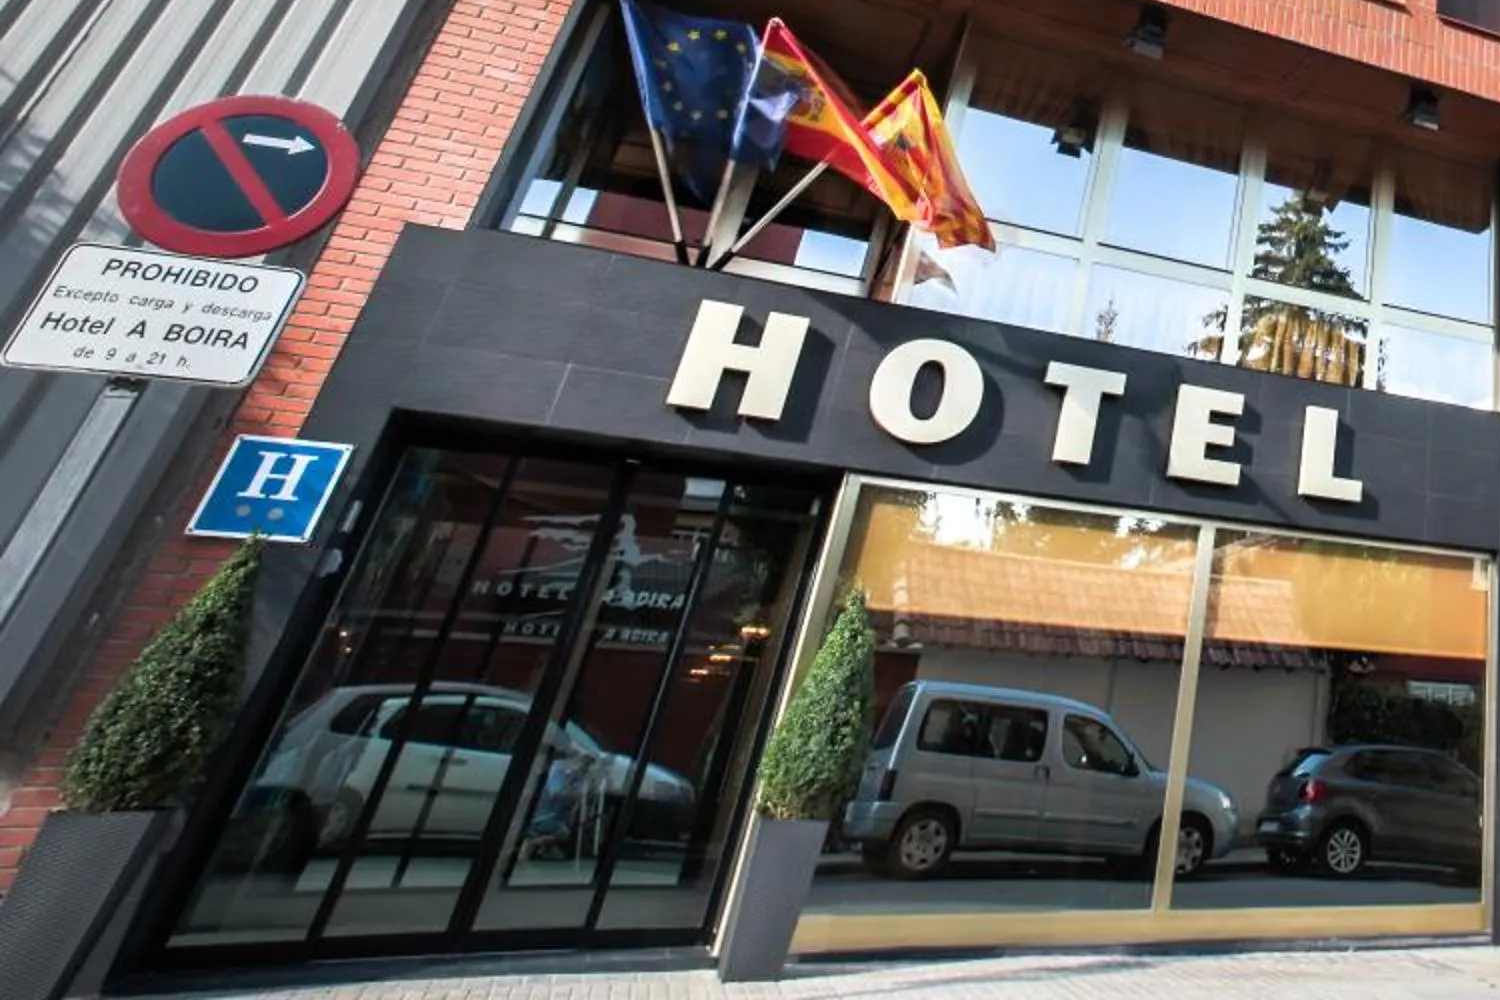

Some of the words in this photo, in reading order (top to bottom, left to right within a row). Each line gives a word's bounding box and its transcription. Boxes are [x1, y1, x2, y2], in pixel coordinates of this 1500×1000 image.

[100, 258, 259, 293] PROHIBIDO
[53, 285, 119, 305] Excepto
[129, 294, 174, 312] carga
[182, 301, 192, 314] y
[201, 300, 273, 323] descarga
[40, 311, 116, 336] Hotel
[127, 320, 147, 339] A
[163, 323, 250, 350] BOIRA
[72, 345, 95, 360] de
[105, 348, 118, 361] 9
[125, 353, 136, 363] a
[147, 351, 166, 365] 21
[176, 354, 192, 369] h.
[666, 299, 1364, 504] HOTEL
[238, 450, 318, 502] H
[472, 580, 576, 601] HOTEL
